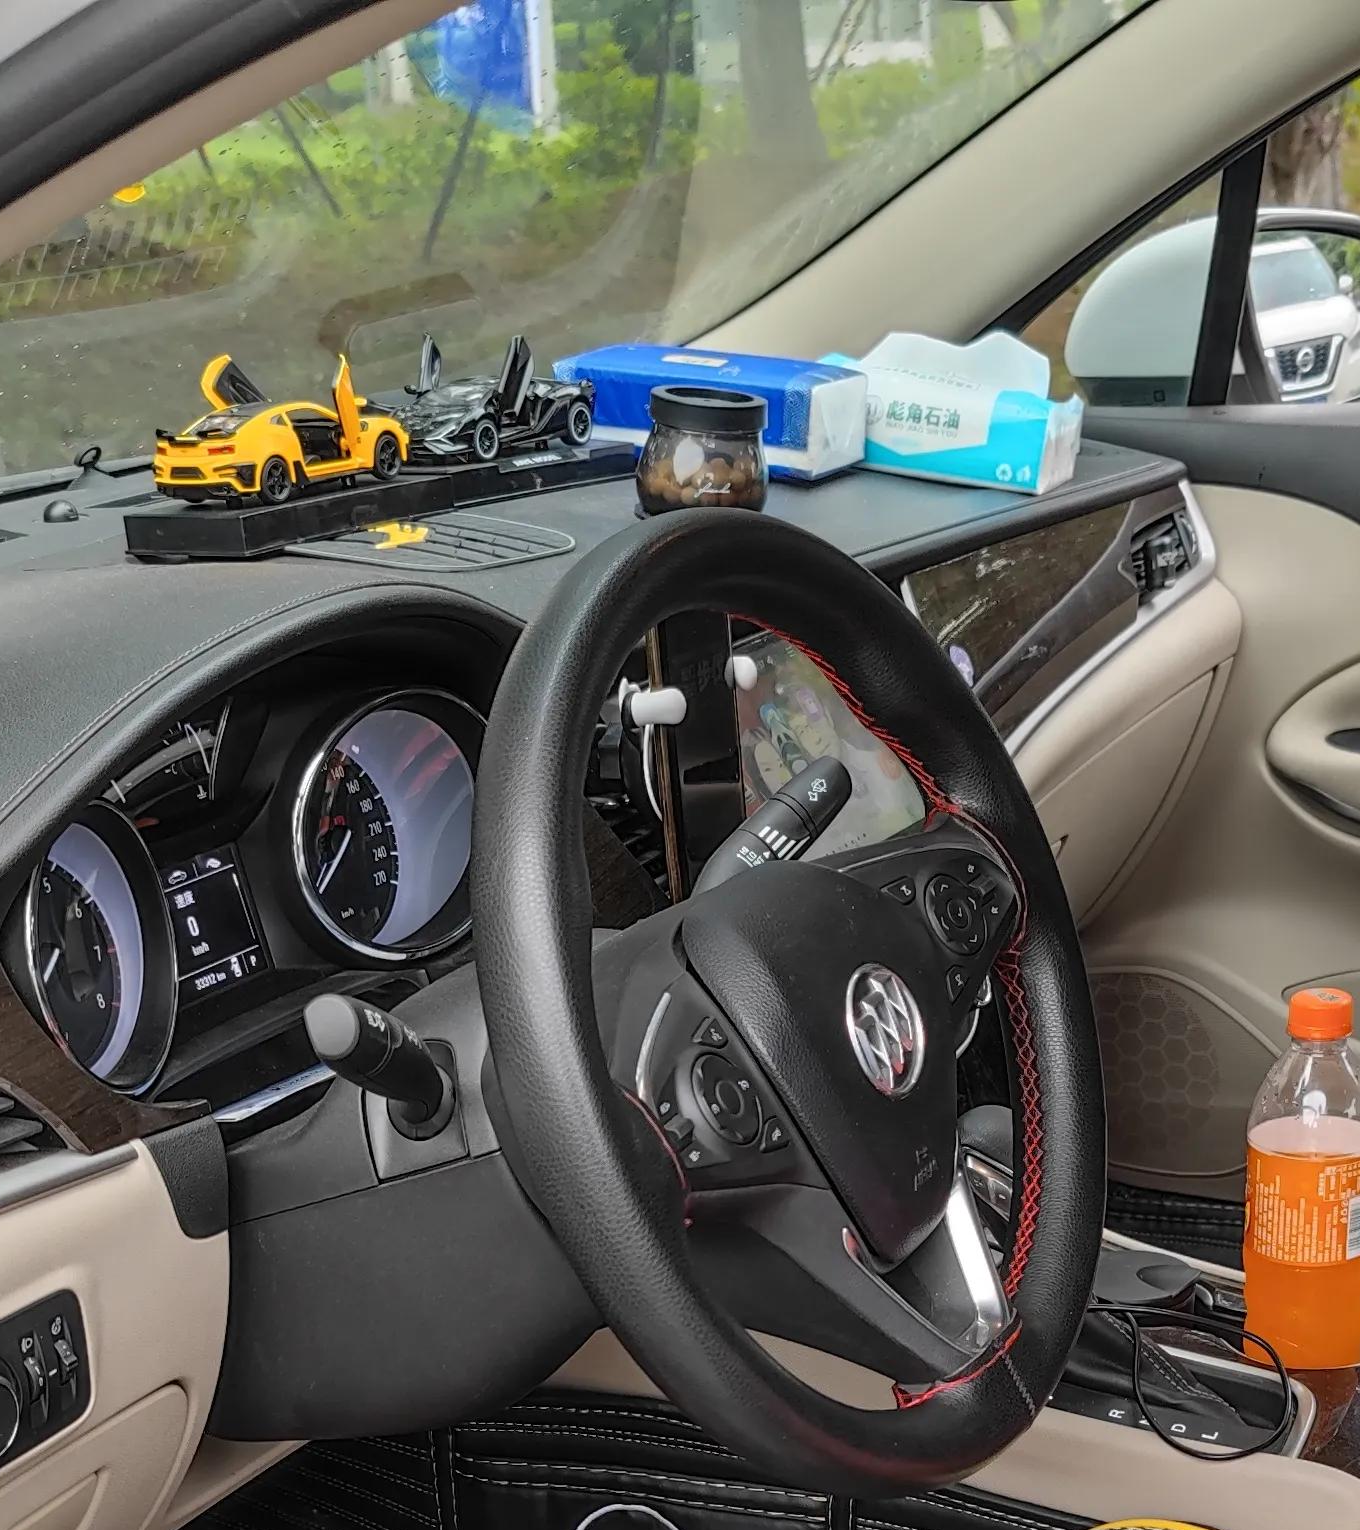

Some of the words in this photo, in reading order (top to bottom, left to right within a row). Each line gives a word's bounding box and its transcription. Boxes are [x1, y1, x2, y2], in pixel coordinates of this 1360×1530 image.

[886, 400, 960, 429] 彪角石油
[330, 765, 345, 781] 140
[346, 778, 360, 794] 160
[360, 797, 373, 813] 180
[368, 820, 383, 837] 210
[373, 845, 387, 862] 240
[42, 877, 52, 893] 5
[373, 870, 387, 886] 270
[75, 903, 83, 918] 6
[186, 915, 200, 937] 0
[93, 945, 102, 962] 7
[96, 993, 106, 1009] 8
[1108, 1409, 1125, 1419] R
[1170, 1423, 1186, 1433] D
[1201, 1432, 1219, 1440] L
